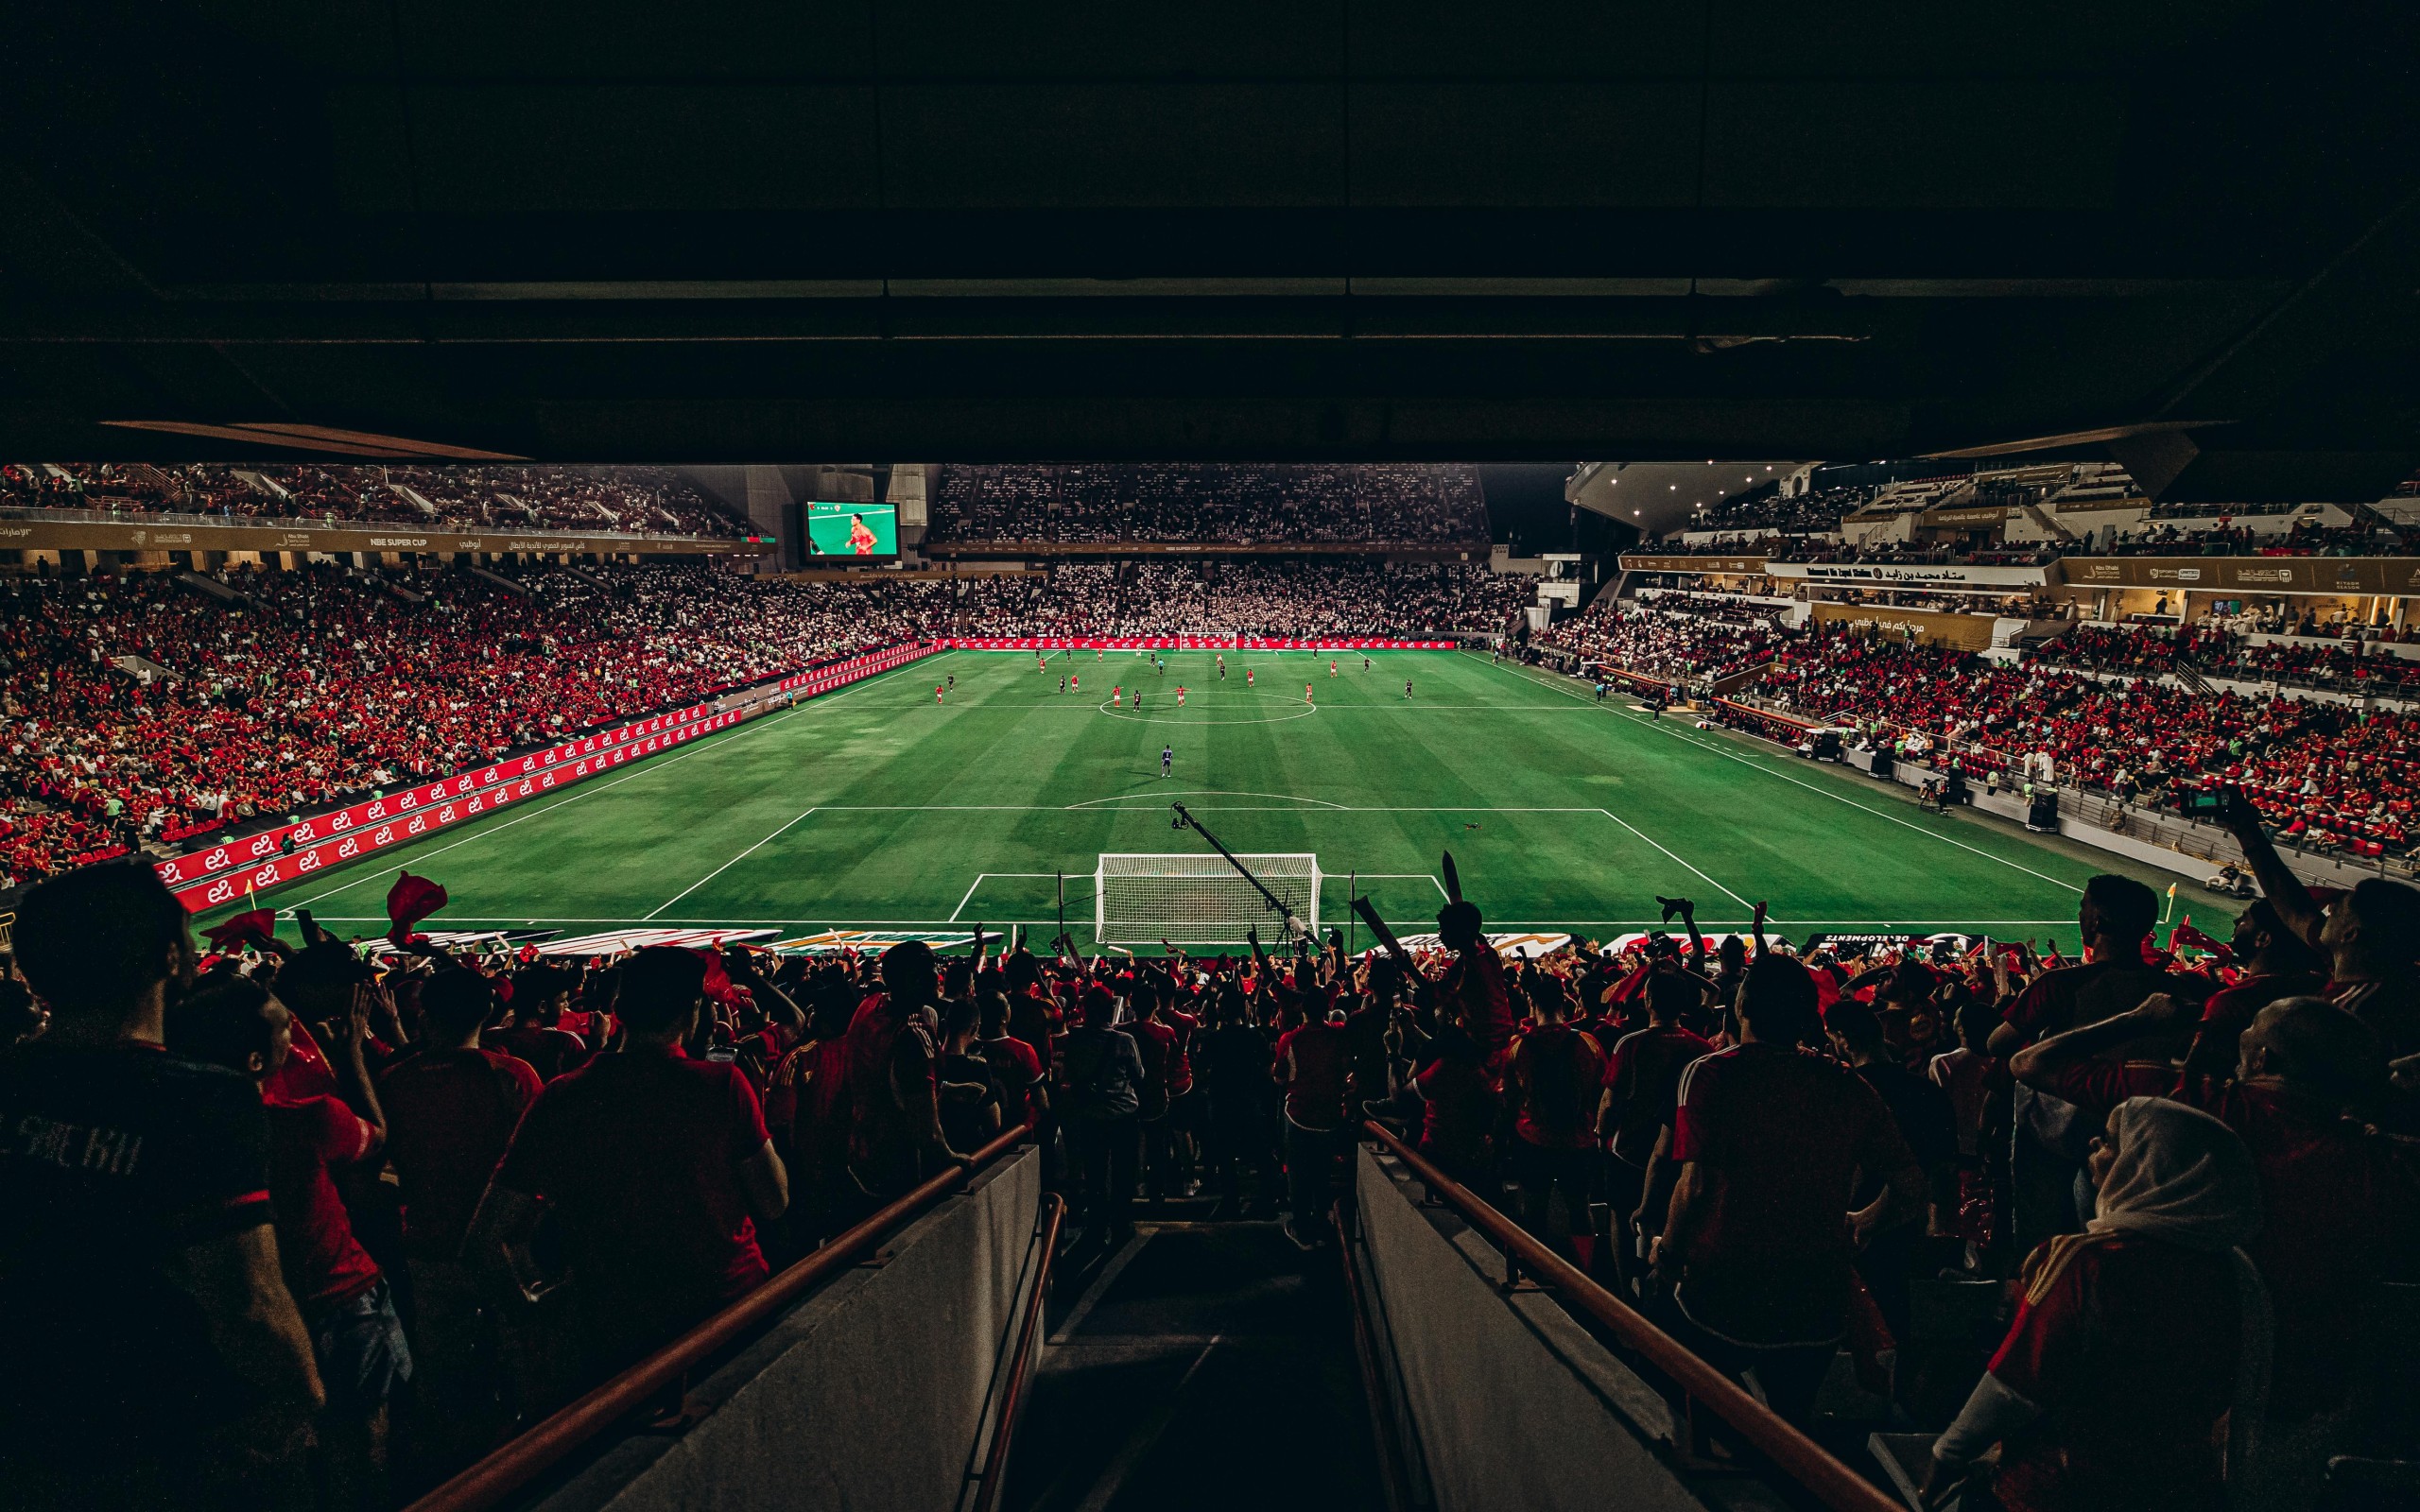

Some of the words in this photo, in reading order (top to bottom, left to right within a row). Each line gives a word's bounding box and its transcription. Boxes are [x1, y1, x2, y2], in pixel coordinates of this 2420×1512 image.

[371, 538, 386, 546] NBE
[459, 538, 481, 549] أبوظبي
[1855, 616, 1879, 629] أوظبي
[1879, 620, 1891, 630] في
